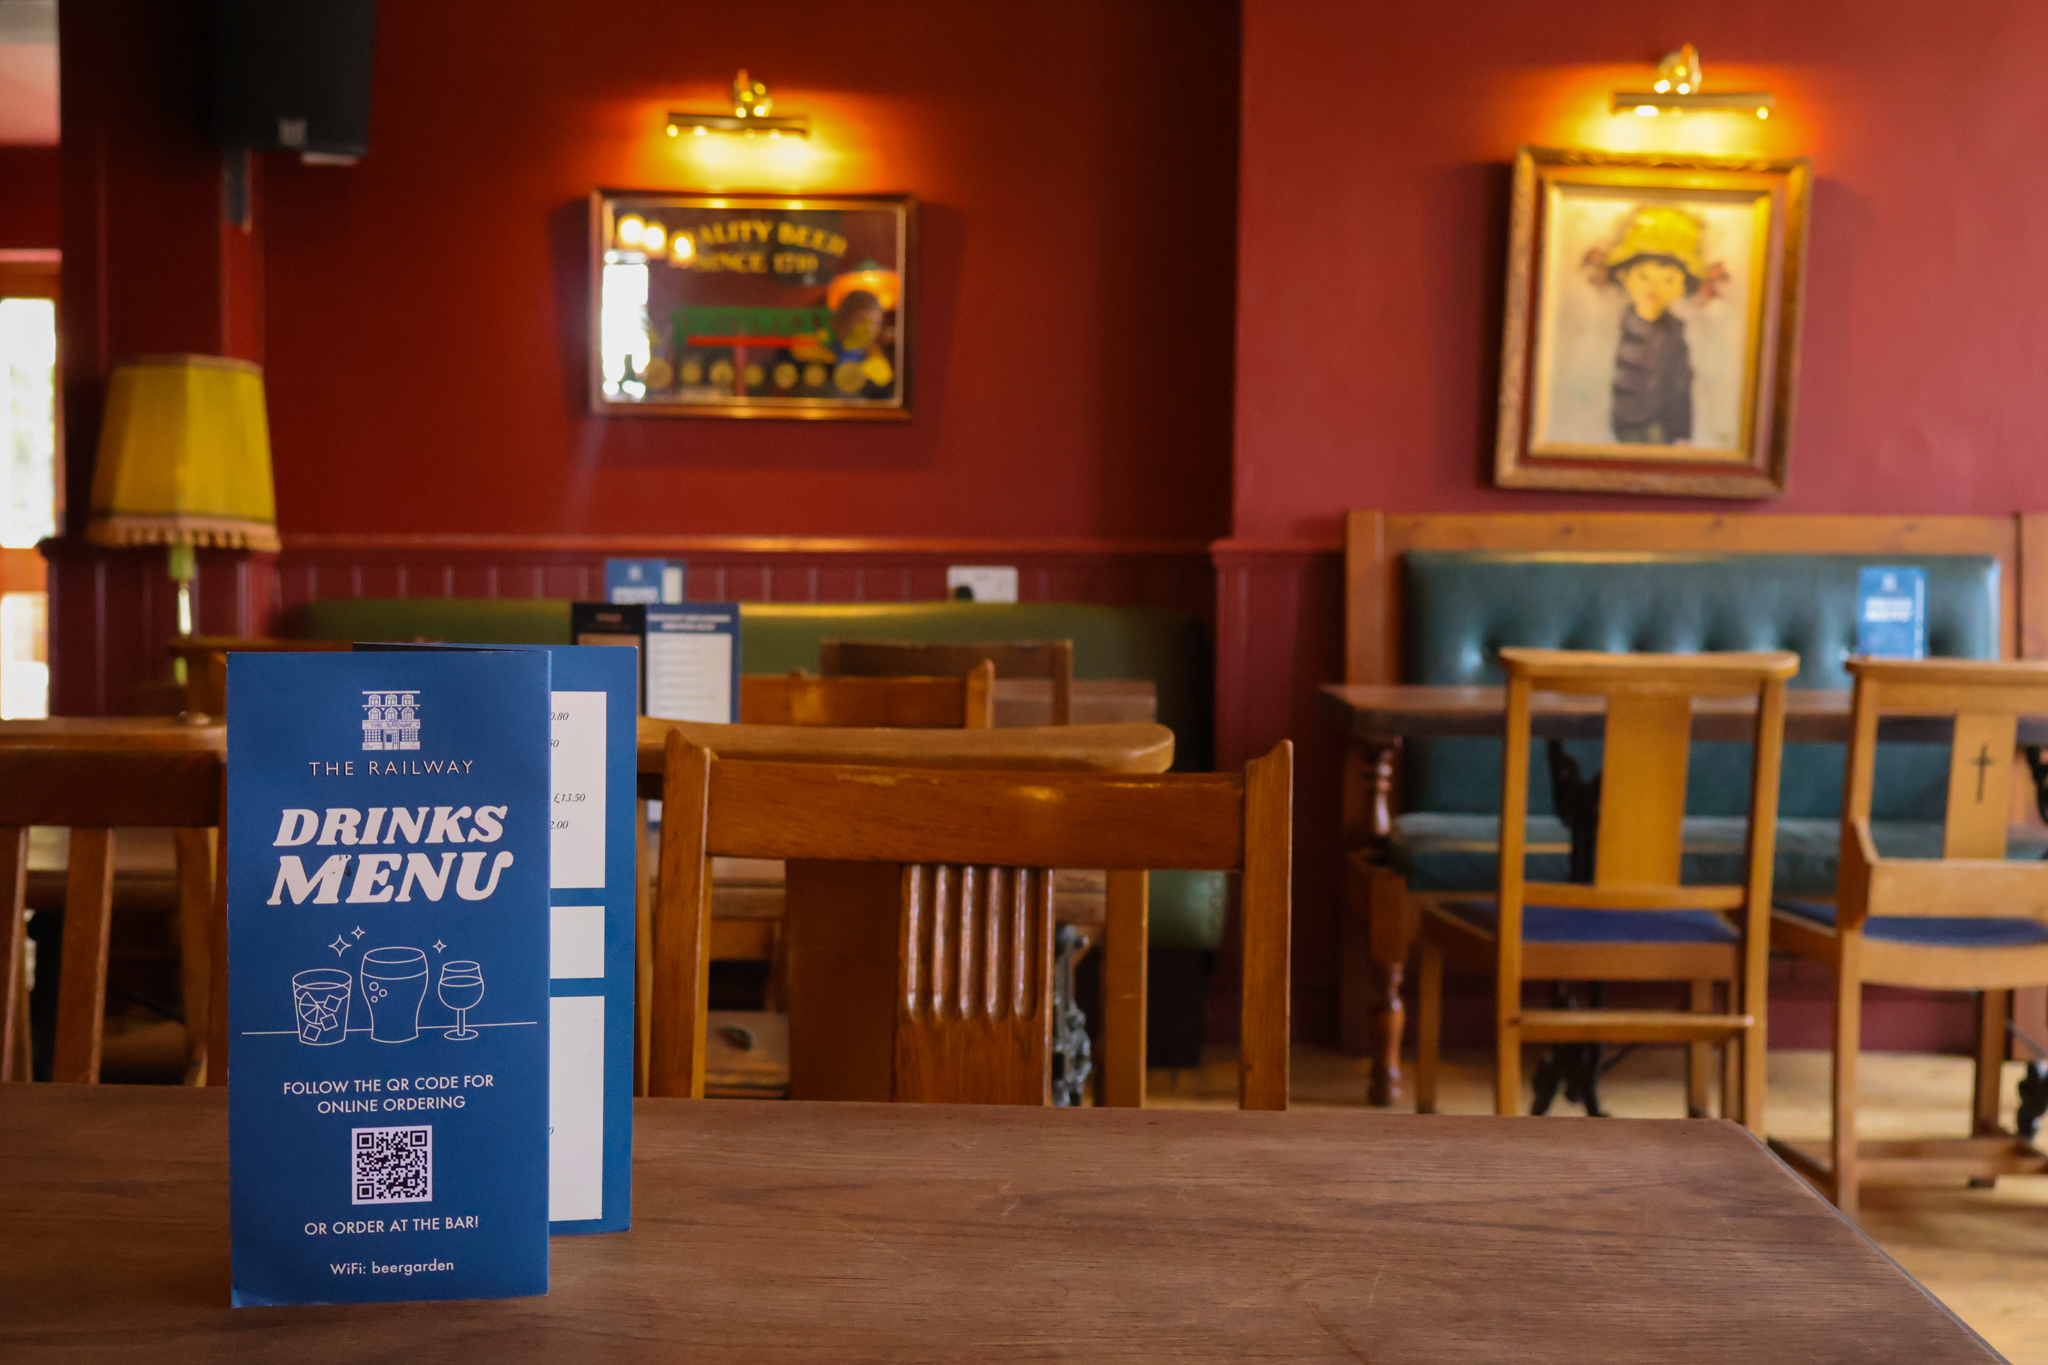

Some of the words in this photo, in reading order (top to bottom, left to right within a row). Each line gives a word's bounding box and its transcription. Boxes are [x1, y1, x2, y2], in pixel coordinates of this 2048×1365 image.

[308, 761, 354, 777] THE
[369, 759, 474, 776] RAILWAY
[553, 793, 586, 804] £13.50
[273, 805, 508, 847] DRINKS
[266, 850, 514, 906] MENU
[283, 1080, 349, 1095] FOLLOW
[353, 1079, 382, 1093] THE
[386, 1078, 410, 1093] QR
[414, 1075, 459, 1091] CODE
[463, 1074, 494, 1088] FOR
[317, 1099, 378, 1114] ONLINE
[382, 1095, 466, 1112] ORDERING
[304, 1222, 328, 1236] OR
[332, 1220, 385, 1235] ORDER
[389, 1219, 408, 1232] AT
[412, 1217, 440, 1231] THE
[445, 1215, 479, 1230] BAR!
[329, 1262, 367, 1275] WiFi:
[371, 1258, 454, 1277] beergarden
